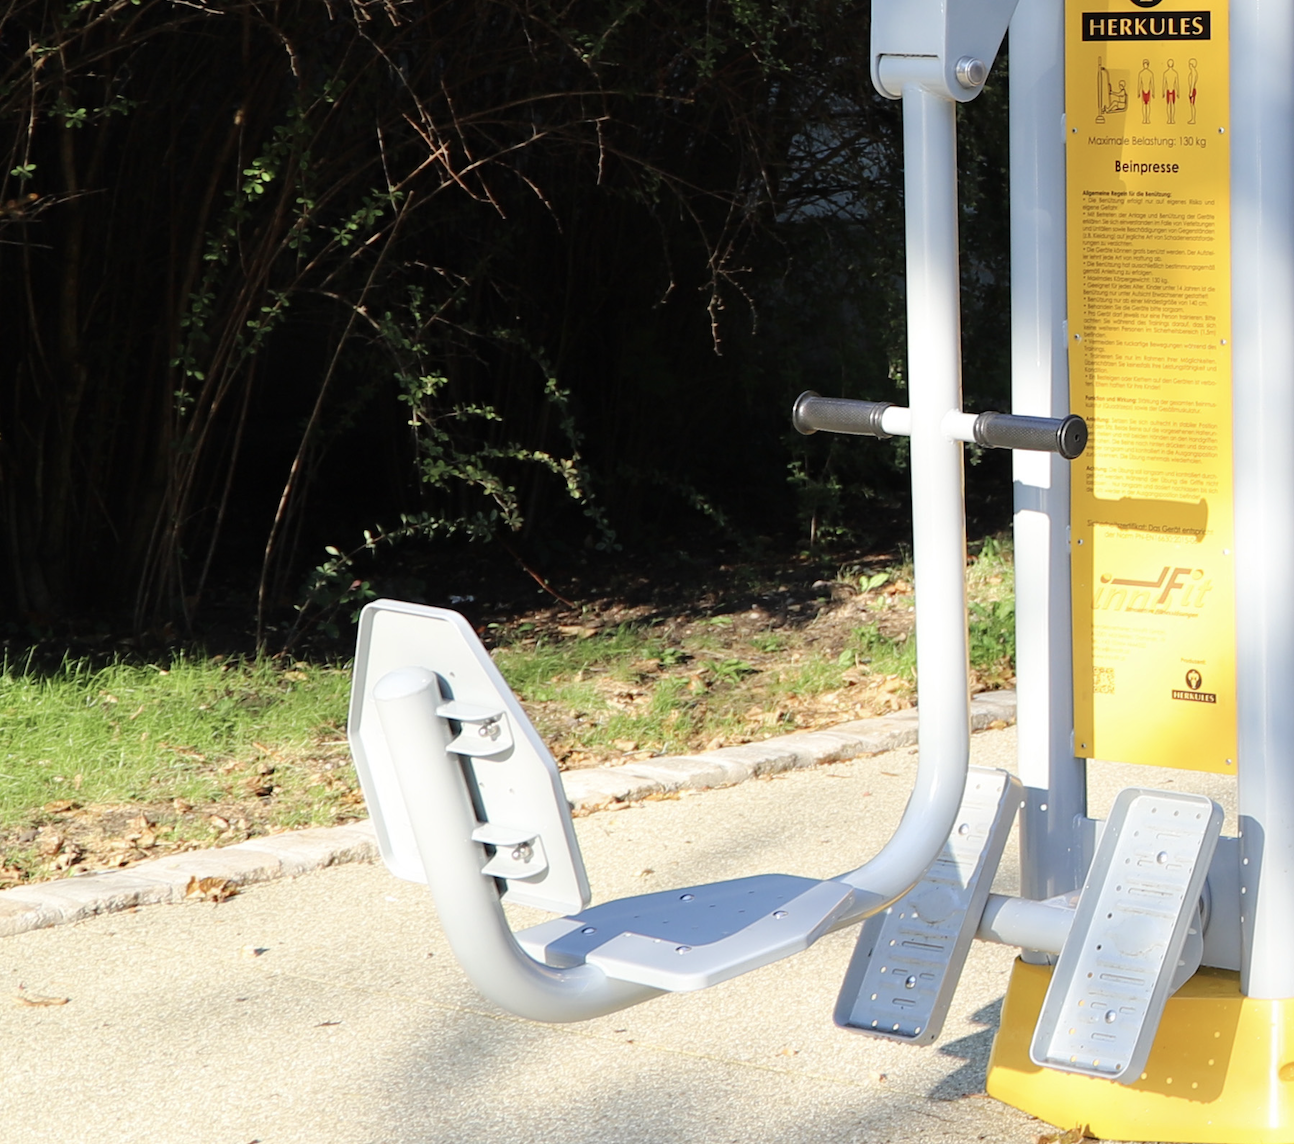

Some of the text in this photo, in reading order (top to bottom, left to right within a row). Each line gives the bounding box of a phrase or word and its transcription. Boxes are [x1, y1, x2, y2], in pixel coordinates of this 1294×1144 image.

[1089, 16, 1204, 36] HERKULES
[1088, 135, 1207, 149] Maximale Belastung: 130 kg
[1115, 160, 1180, 175] Beinpresse
[1149, 524, 1160, 532] Das
[1161, 525, 1181, 534] Gerät
[1173, 691, 1215, 703] HERKULES
